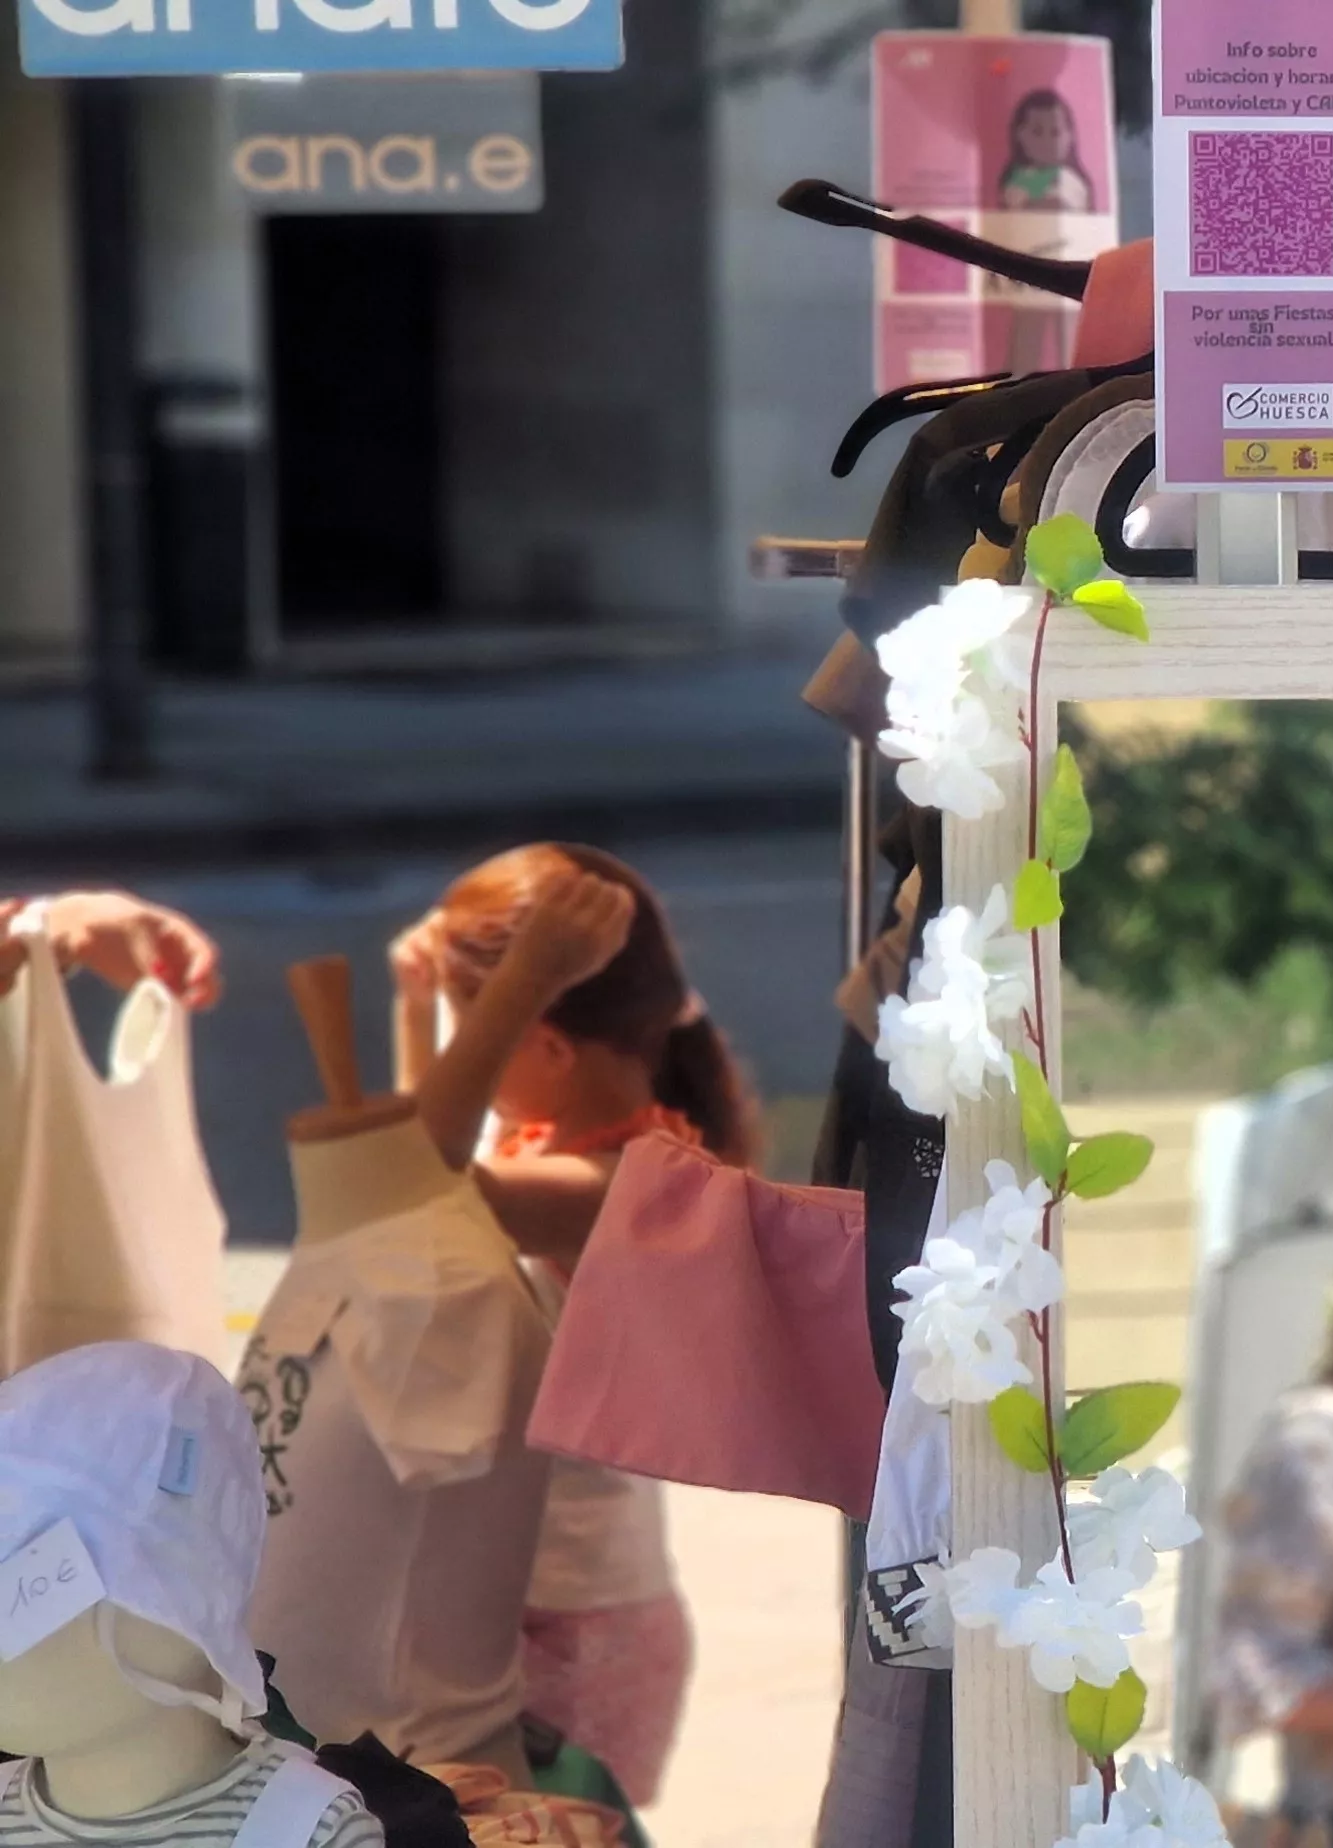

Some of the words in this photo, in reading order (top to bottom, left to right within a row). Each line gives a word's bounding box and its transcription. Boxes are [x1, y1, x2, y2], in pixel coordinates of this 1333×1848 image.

[1227, 42, 1264, 58] Info
[1268, 43, 1318, 59] sobre
[1275, 71, 1284, 88] y
[1174, 94, 1288, 111] Puntovioleta
[1292, 98, 1301, 115] y
[232, 132, 534, 192] ana.e
[1192, 305, 1225, 321] Por
[1229, 307, 1270, 322] unas
[1249, 321, 1274, 335] sin
[1193, 331, 1273, 348] violencia
[1259, 392, 1330, 405] COMERCIO
[1259, 406, 1330, 420] HUESCA
